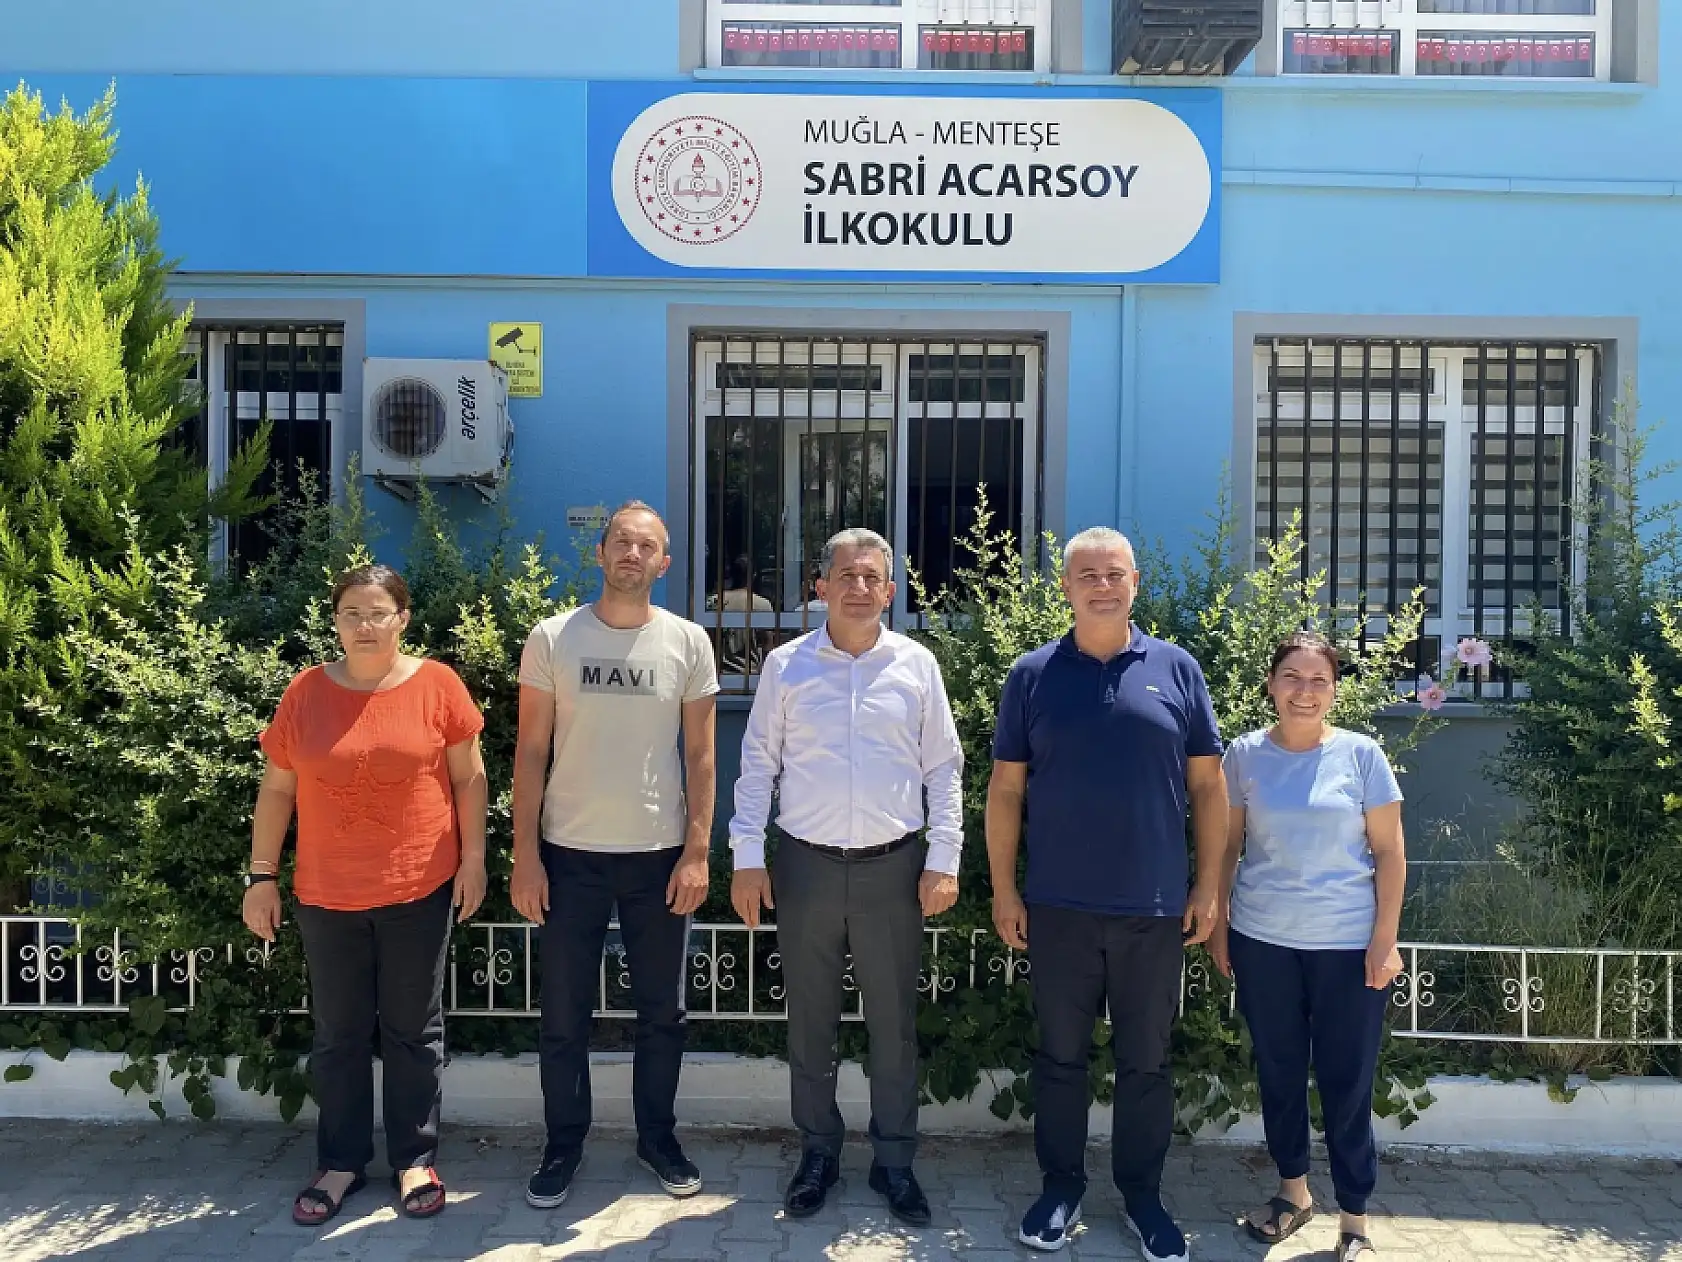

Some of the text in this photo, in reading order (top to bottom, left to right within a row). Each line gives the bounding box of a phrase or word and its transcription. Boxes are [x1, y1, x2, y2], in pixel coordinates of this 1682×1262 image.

[804, 116, 907, 144] MUĞLA
[933, 121, 1060, 151] MENTEŞE
[804, 155, 1139, 197] SABRİ ACARSOY
[804, 204, 1012, 245] İLKOKULU
[458, 375, 480, 440] arçelik
[582, 665, 654, 687] MAVI
